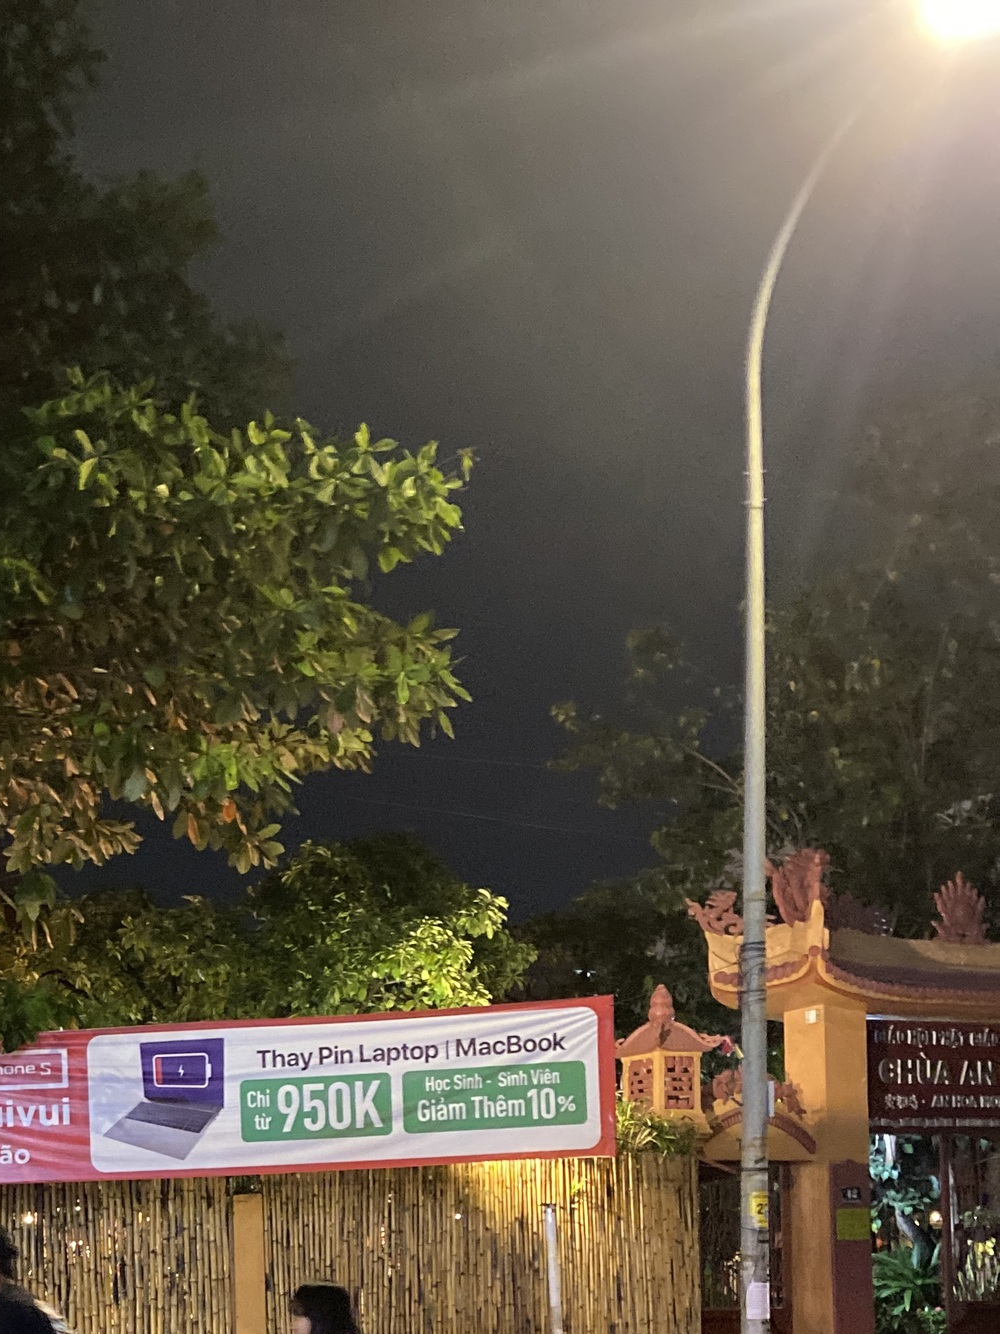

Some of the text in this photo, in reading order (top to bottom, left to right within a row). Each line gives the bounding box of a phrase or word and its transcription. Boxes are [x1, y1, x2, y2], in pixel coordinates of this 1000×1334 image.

[256, 1049, 313, 1071] Thay
[319, 1045, 354, 1065] Pin
[359, 1043, 439, 1066] Laptop
[455, 1033, 566, 1057] MacBook
[425, 1076, 451, 1095] Học
[453, 1074, 483, 1090] Sinh
[497, 1070, 528, 1087] Sinh
[530, 1069, 560, 1085] Viên
[878, 1051, 993, 1086] CHÙA AN
[247, 1089, 271, 1108] Chỉ
[277, 1080, 384, 1133] 950K
[417, 1096, 467, 1122] Giảm
[470, 1095, 526, 1119] Thêm
[254, 1113, 273, 1131] từ
